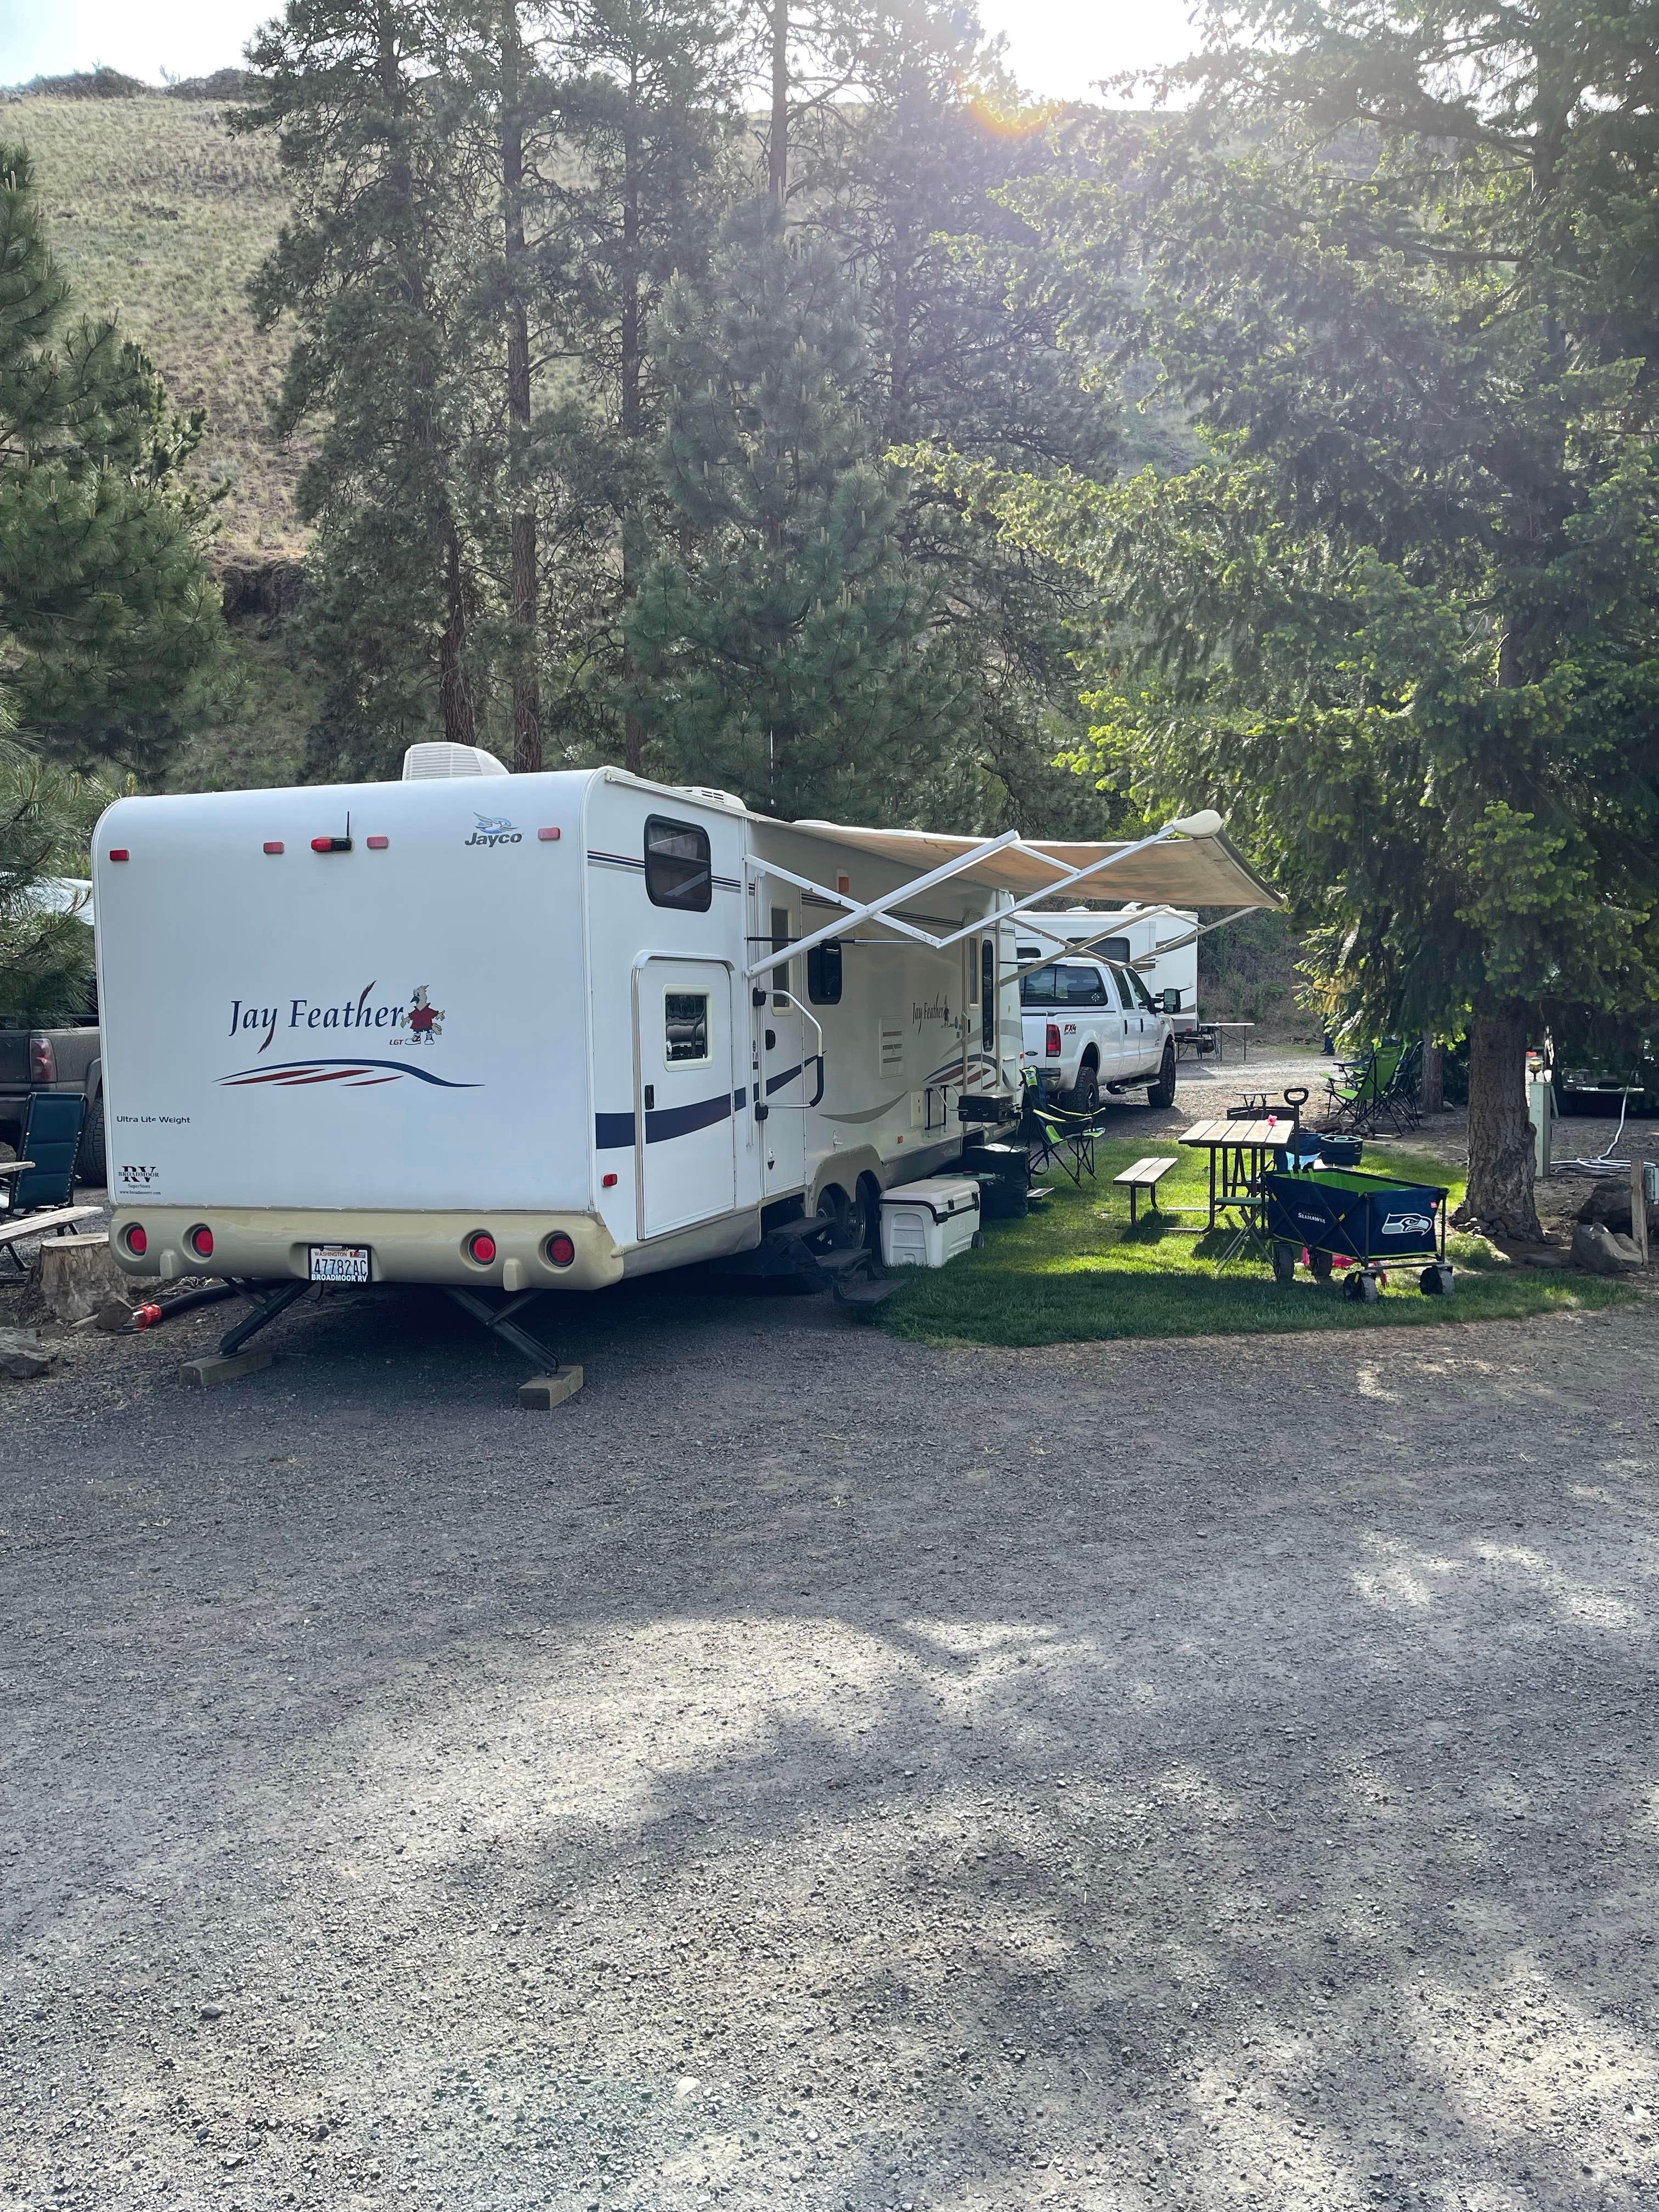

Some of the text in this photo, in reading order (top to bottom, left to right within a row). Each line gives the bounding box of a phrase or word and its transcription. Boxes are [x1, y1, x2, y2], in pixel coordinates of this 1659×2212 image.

[465, 832, 522, 848] Jayco
[228, 980, 404, 1054] Jay Feather
[912, 992, 944, 1036] Jay Feather
[1064, 1024, 1076, 1032] FX4
[122, 1166, 156, 1182] RV
[1297, 1212, 1325, 1224] SEAHAWKS
[314, 1259, 367, 1276] 47782AC
[311, 1273, 357, 1282] BROADMOOR
